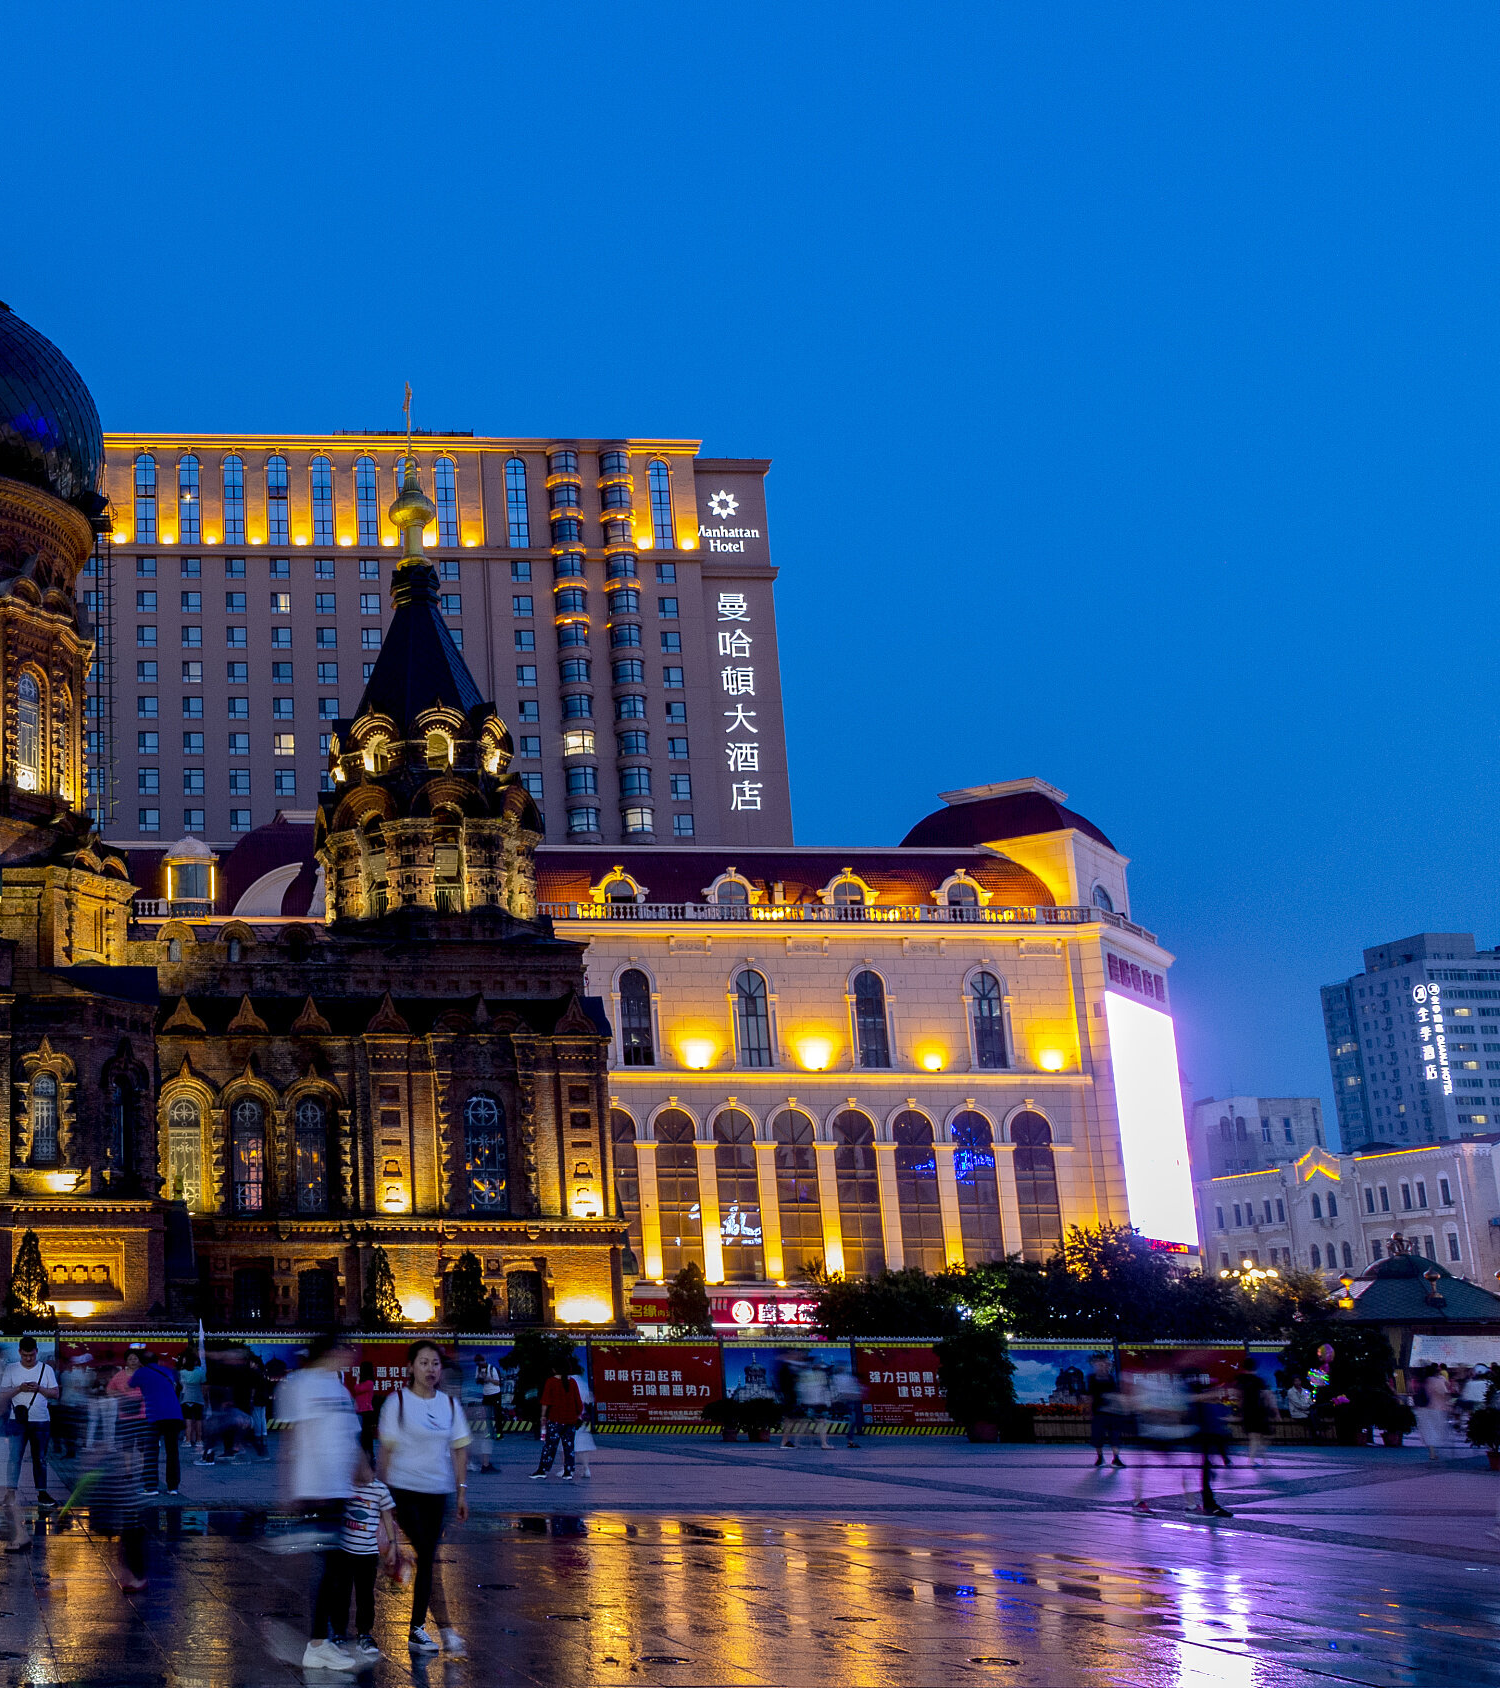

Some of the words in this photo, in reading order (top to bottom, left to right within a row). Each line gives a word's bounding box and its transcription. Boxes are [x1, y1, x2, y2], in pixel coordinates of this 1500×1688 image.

[709, 540, 745, 553] Hotel
[717, 592, 763, 811] 曼哈頓大酒店
[604, 1369, 682, 1382] 积极行动起来
[869, 1371, 940, 1383] 强力扫除黑
[632, 1384, 711, 1397] 扫除黑恶势力
